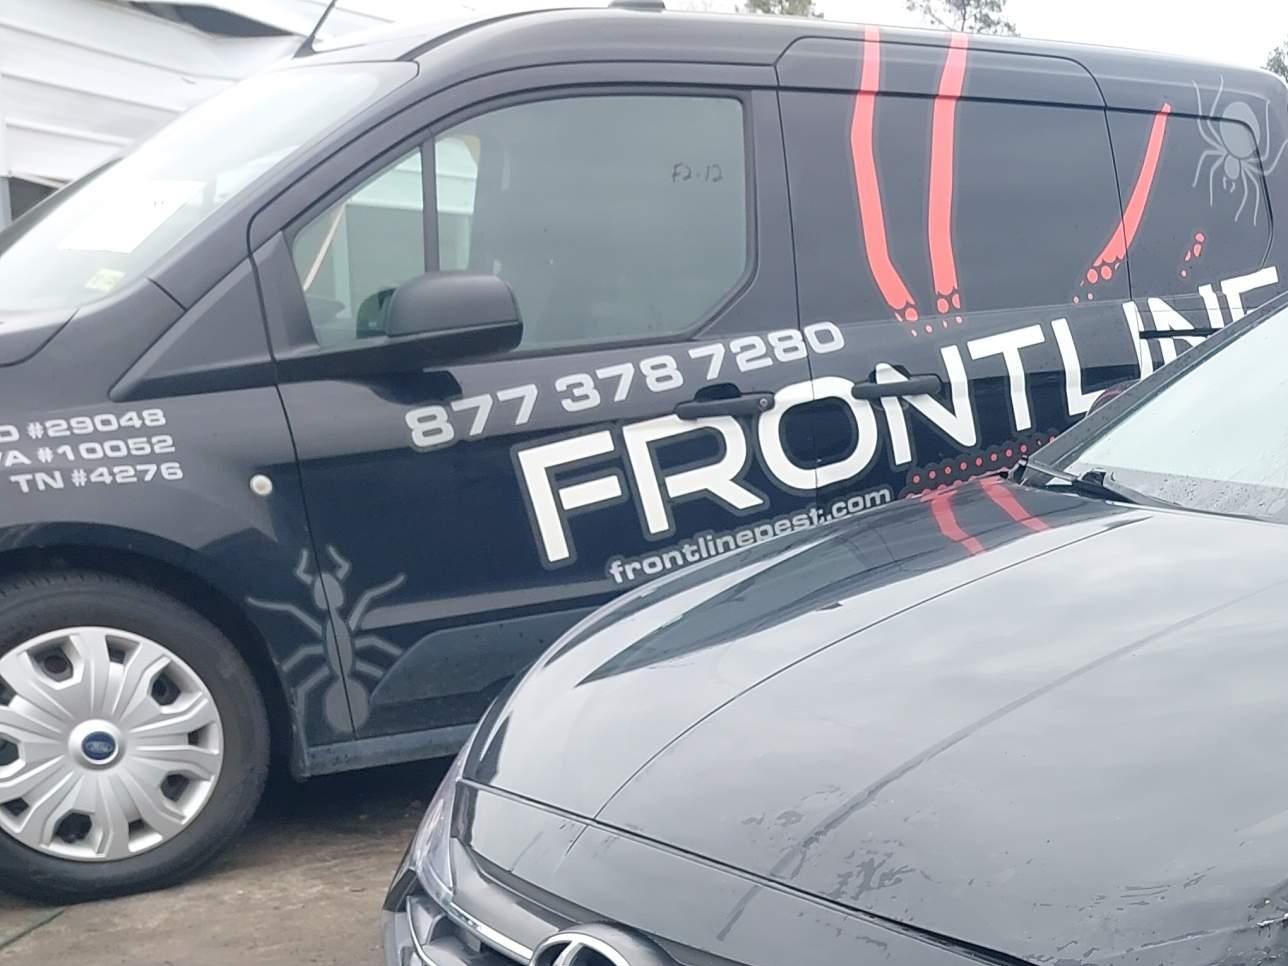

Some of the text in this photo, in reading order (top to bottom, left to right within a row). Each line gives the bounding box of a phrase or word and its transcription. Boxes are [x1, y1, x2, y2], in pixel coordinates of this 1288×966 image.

[405, 322, 845, 447] 877 378 7280
[27, 409, 166, 439] #29048
[37, 435, 175, 463] #10052
[10, 462, 184, 493] TN #4276
[608, 488, 891, 584] frontlinepest.com
